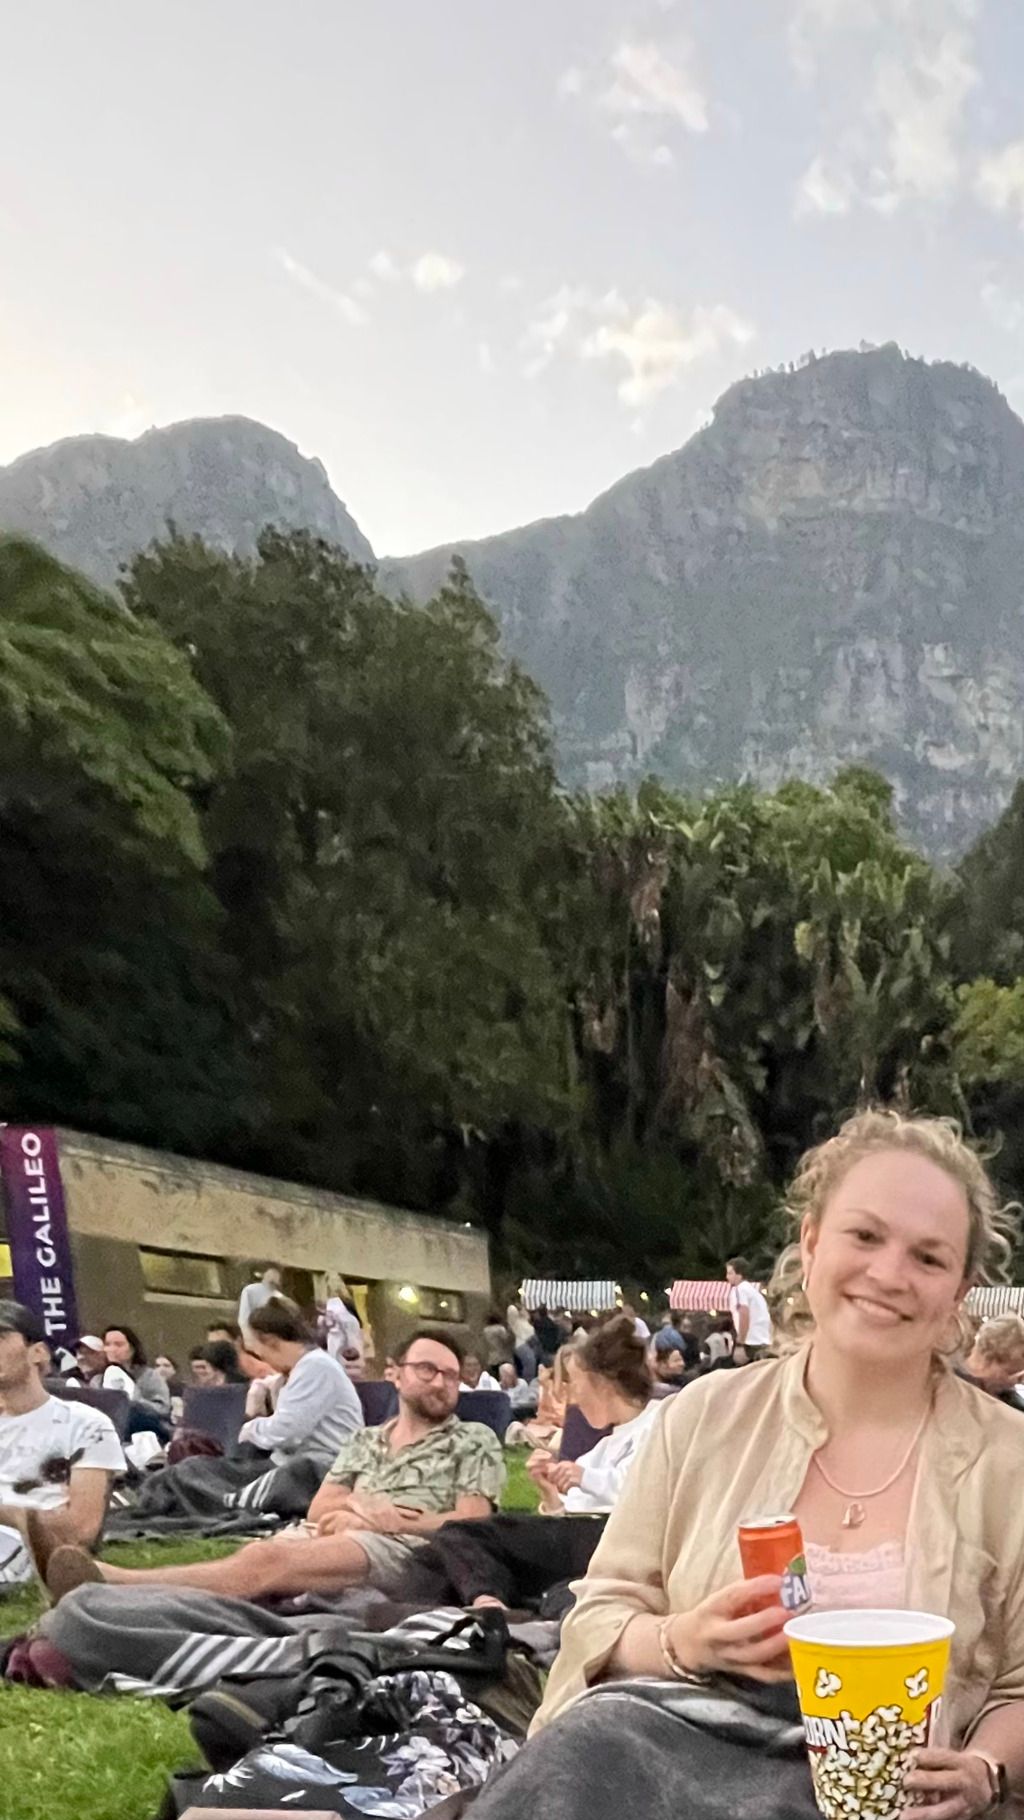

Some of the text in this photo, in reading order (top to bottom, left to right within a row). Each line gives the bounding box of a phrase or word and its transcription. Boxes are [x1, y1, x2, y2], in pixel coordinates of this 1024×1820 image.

[21, 1132, 67, 1336] THE GALILEO
[780, 1575, 810, 1609] FA
[802, 1715, 849, 1751] ORN
